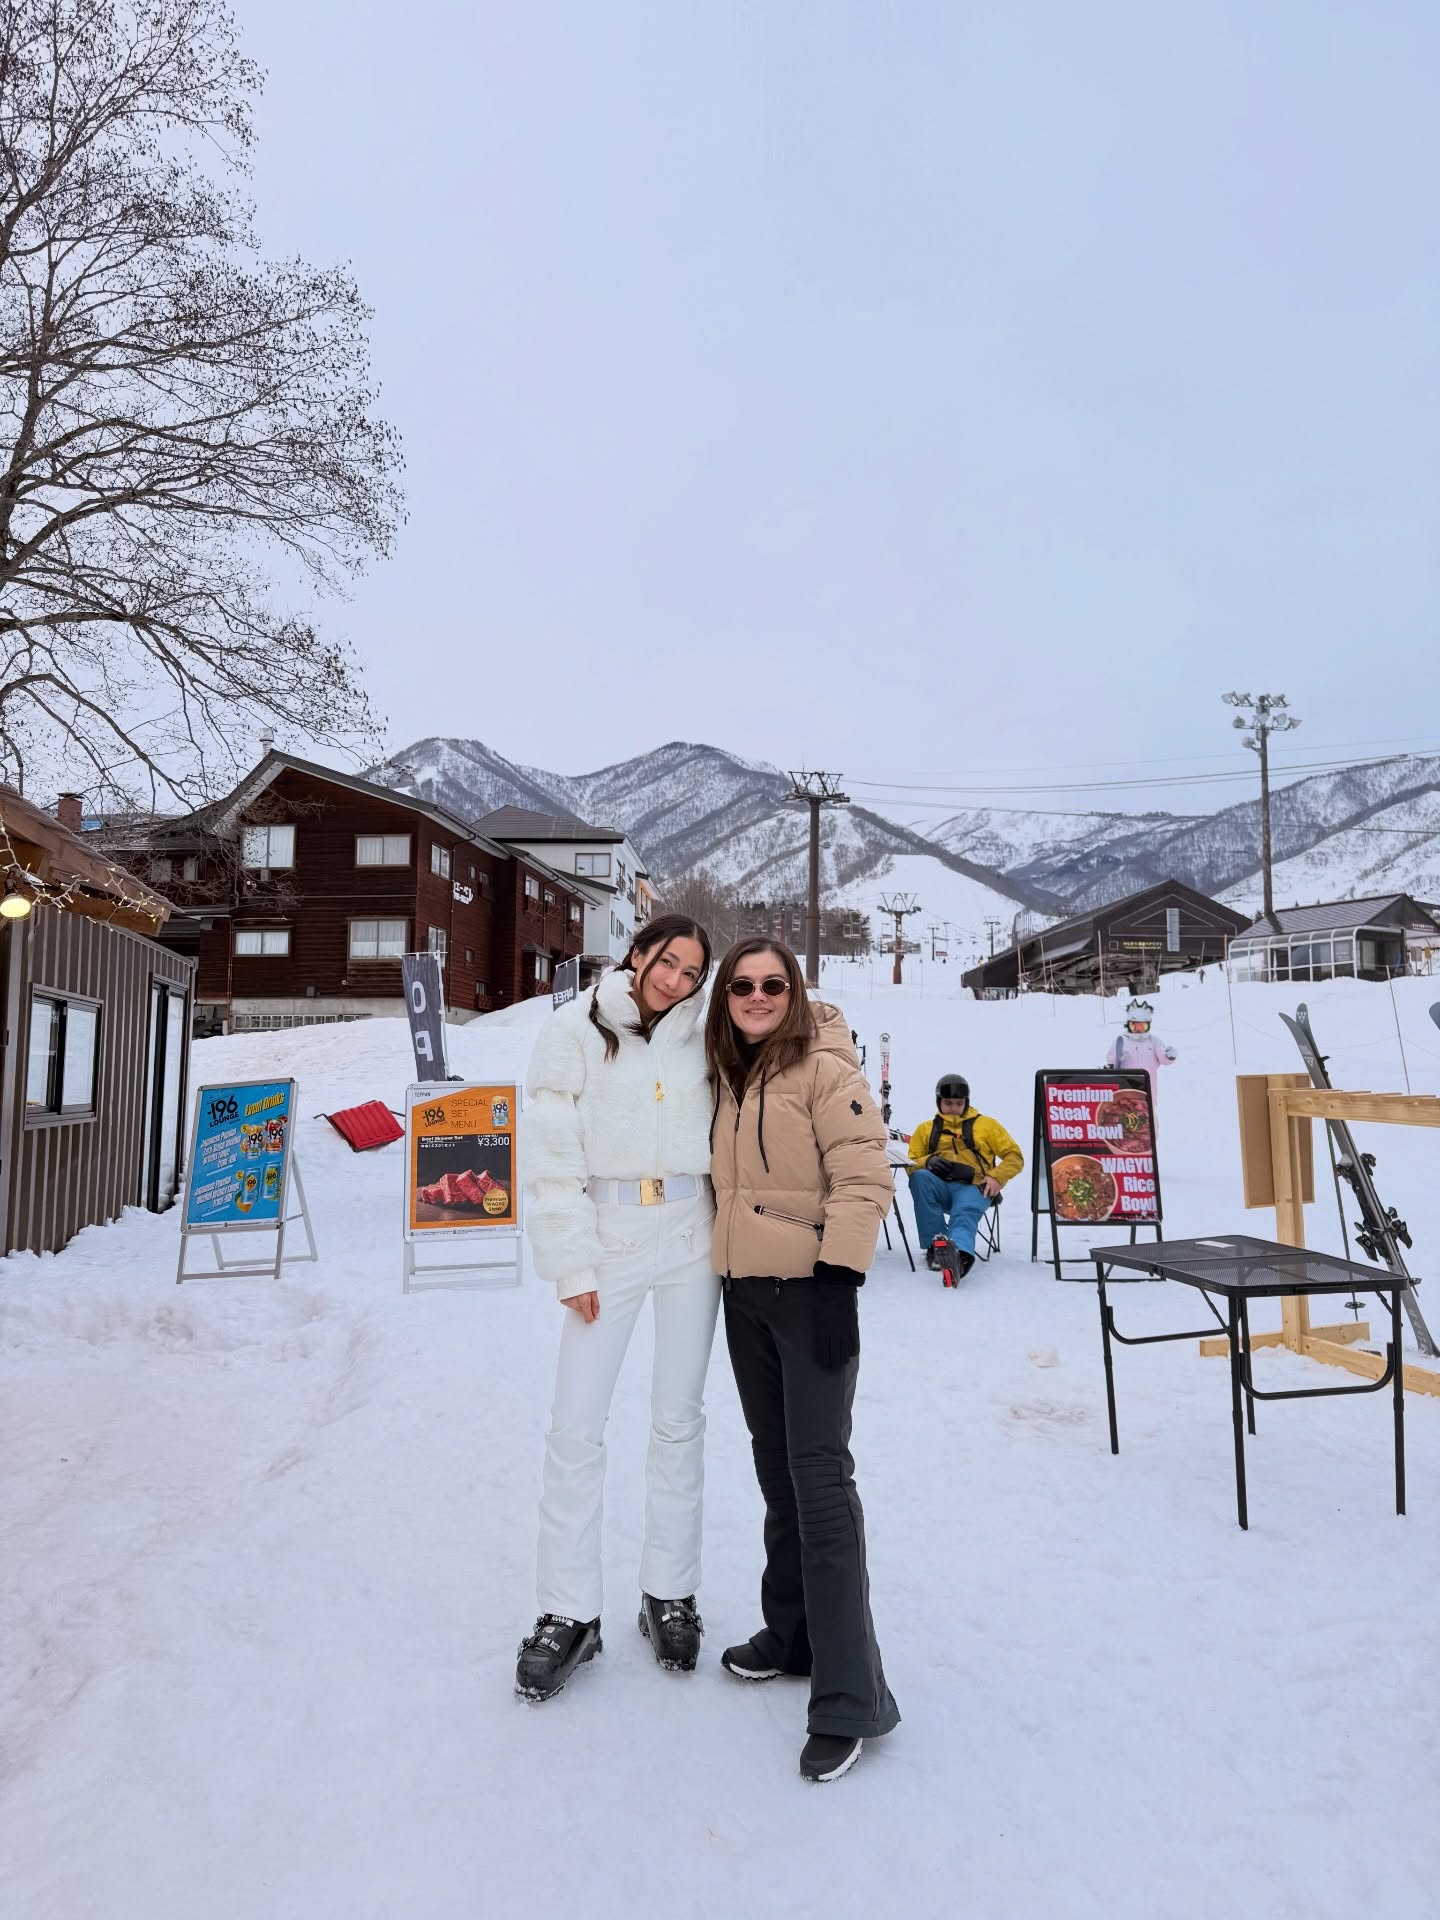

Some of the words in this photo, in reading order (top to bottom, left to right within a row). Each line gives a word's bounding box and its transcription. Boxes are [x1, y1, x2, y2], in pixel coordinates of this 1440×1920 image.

[1048, 1087, 1114, 1102] Premium
[208, 1095, 238, 1119] -196
[451, 1099, 488, 1107] SPECIAL
[210, 1112, 239, 1127] LOUNGE
[452, 1110, 468, 1118] SET
[1050, 1105, 1091, 1121] Steak
[451, 1120, 477, 1128] MENU
[1051, 1124, 1083, 1139] Rice
[1087, 1124, 1123, 1139] Bowl
[477, 1136, 510, 1147] ¥3,300
[1101, 1158, 1153, 1173] WAGYU
[1123, 1176, 1155, 1192] Rice
[1121, 1195, 1157, 1212] Bowl
